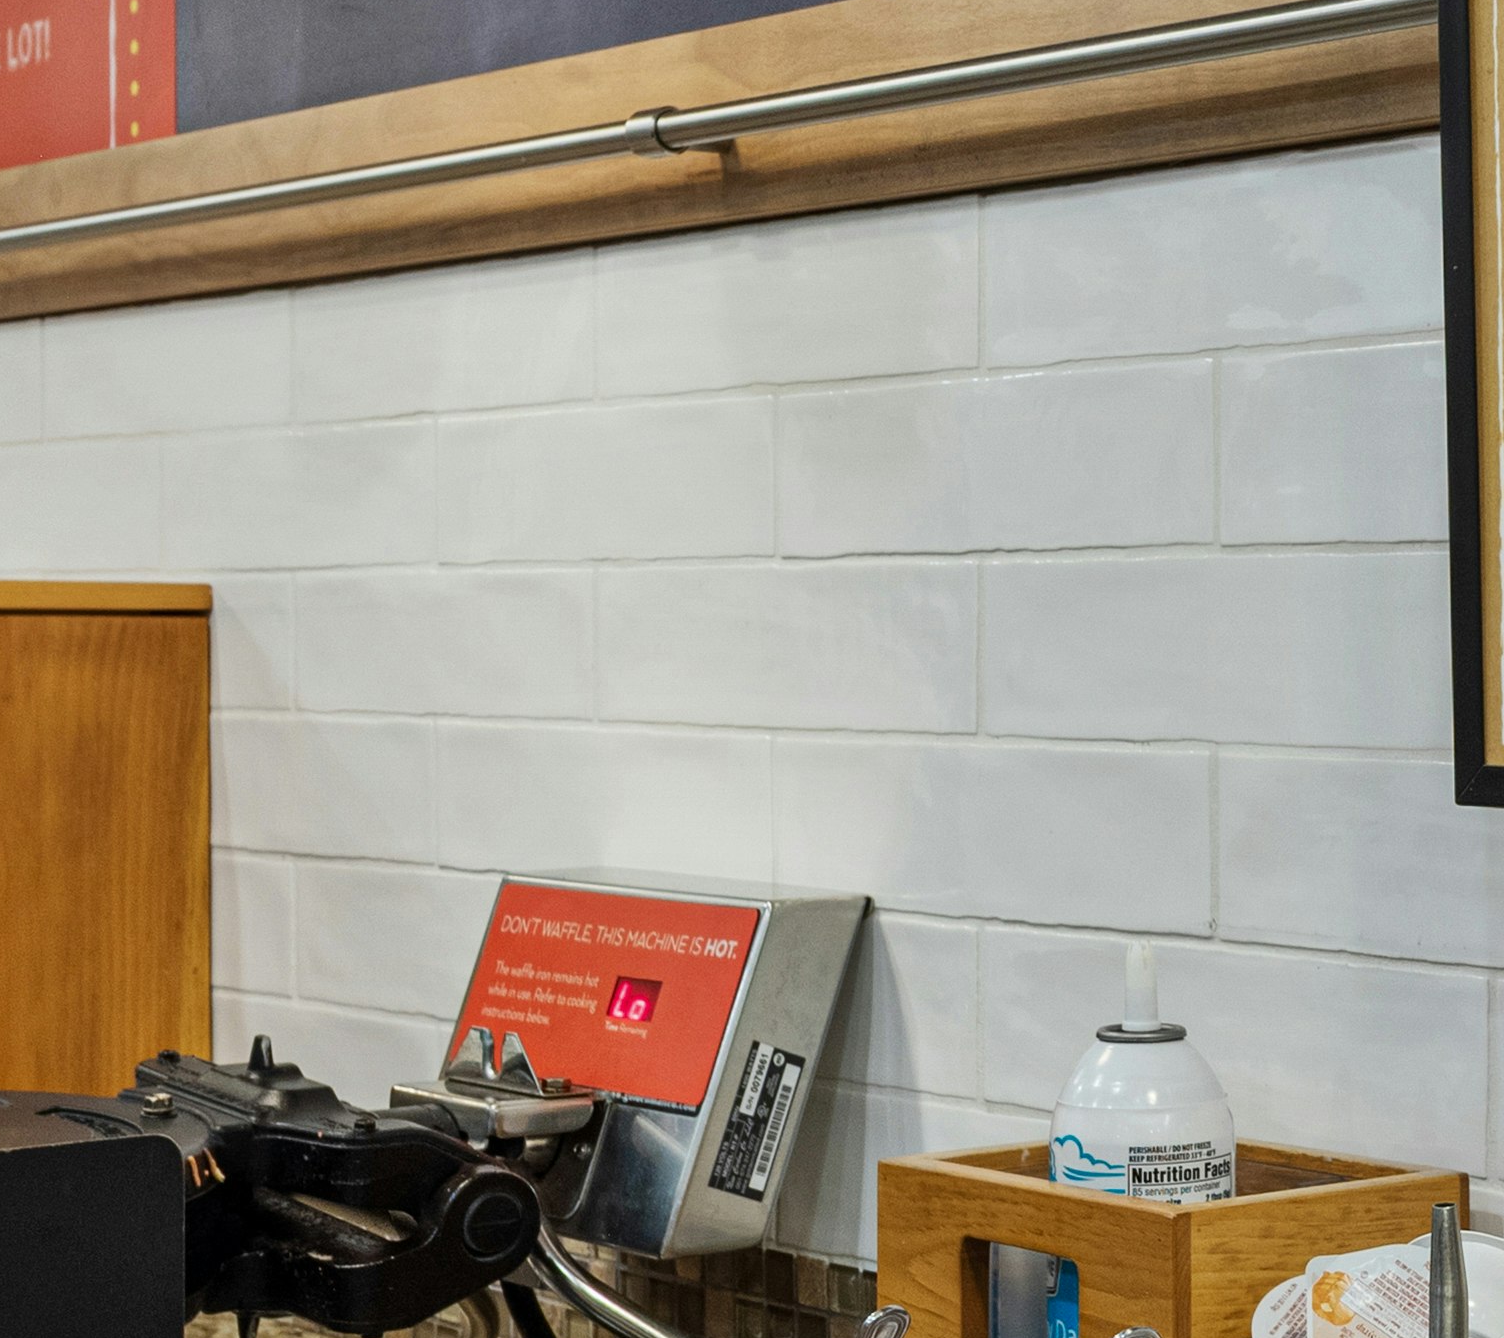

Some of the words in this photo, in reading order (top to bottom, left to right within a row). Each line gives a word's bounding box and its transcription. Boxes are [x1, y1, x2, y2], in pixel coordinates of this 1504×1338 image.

[6, 17, 51, 67] LOT!
[500, 914, 542, 936] DON'T
[596, 925, 623, 947] THIS
[626, 930, 689, 953] MACHINE
[689, 935, 702, 955] IS
[704, 939, 738, 959] HOT.
[496, 959, 509, 975] The
[511, 962, 535, 978] waffle
[536, 967, 551, 981] iron
[552, 970, 583, 985] remains
[585, 972, 599, 987] hot
[488, 983, 507, 998] while
[535, 988, 555, 1004] Refer
[557, 992, 566, 1005] to
[567, 994, 597, 1014] cooking
[481, 1004, 524, 1023] instructions
[1129, 1146, 1167, 1154] PERISHABLE
[1172, 1144, 1181, 1153] DO
[1182, 1143, 1193, 1152] NOT
[1129, 1155, 1145, 1163] KEEP
[1146, 1152, 1190, 1162] REFRIGERATED
[1132, 1165, 1200, 1183] Nutrition
[1204, 1159, 1231, 1178] Facts
[1132, 1187, 1143, 1197] 85
[1145, 1184, 1178, 1197] servings
[1180, 1184, 1192, 1196] per
[1193, 1180, 1221, 1192] container
